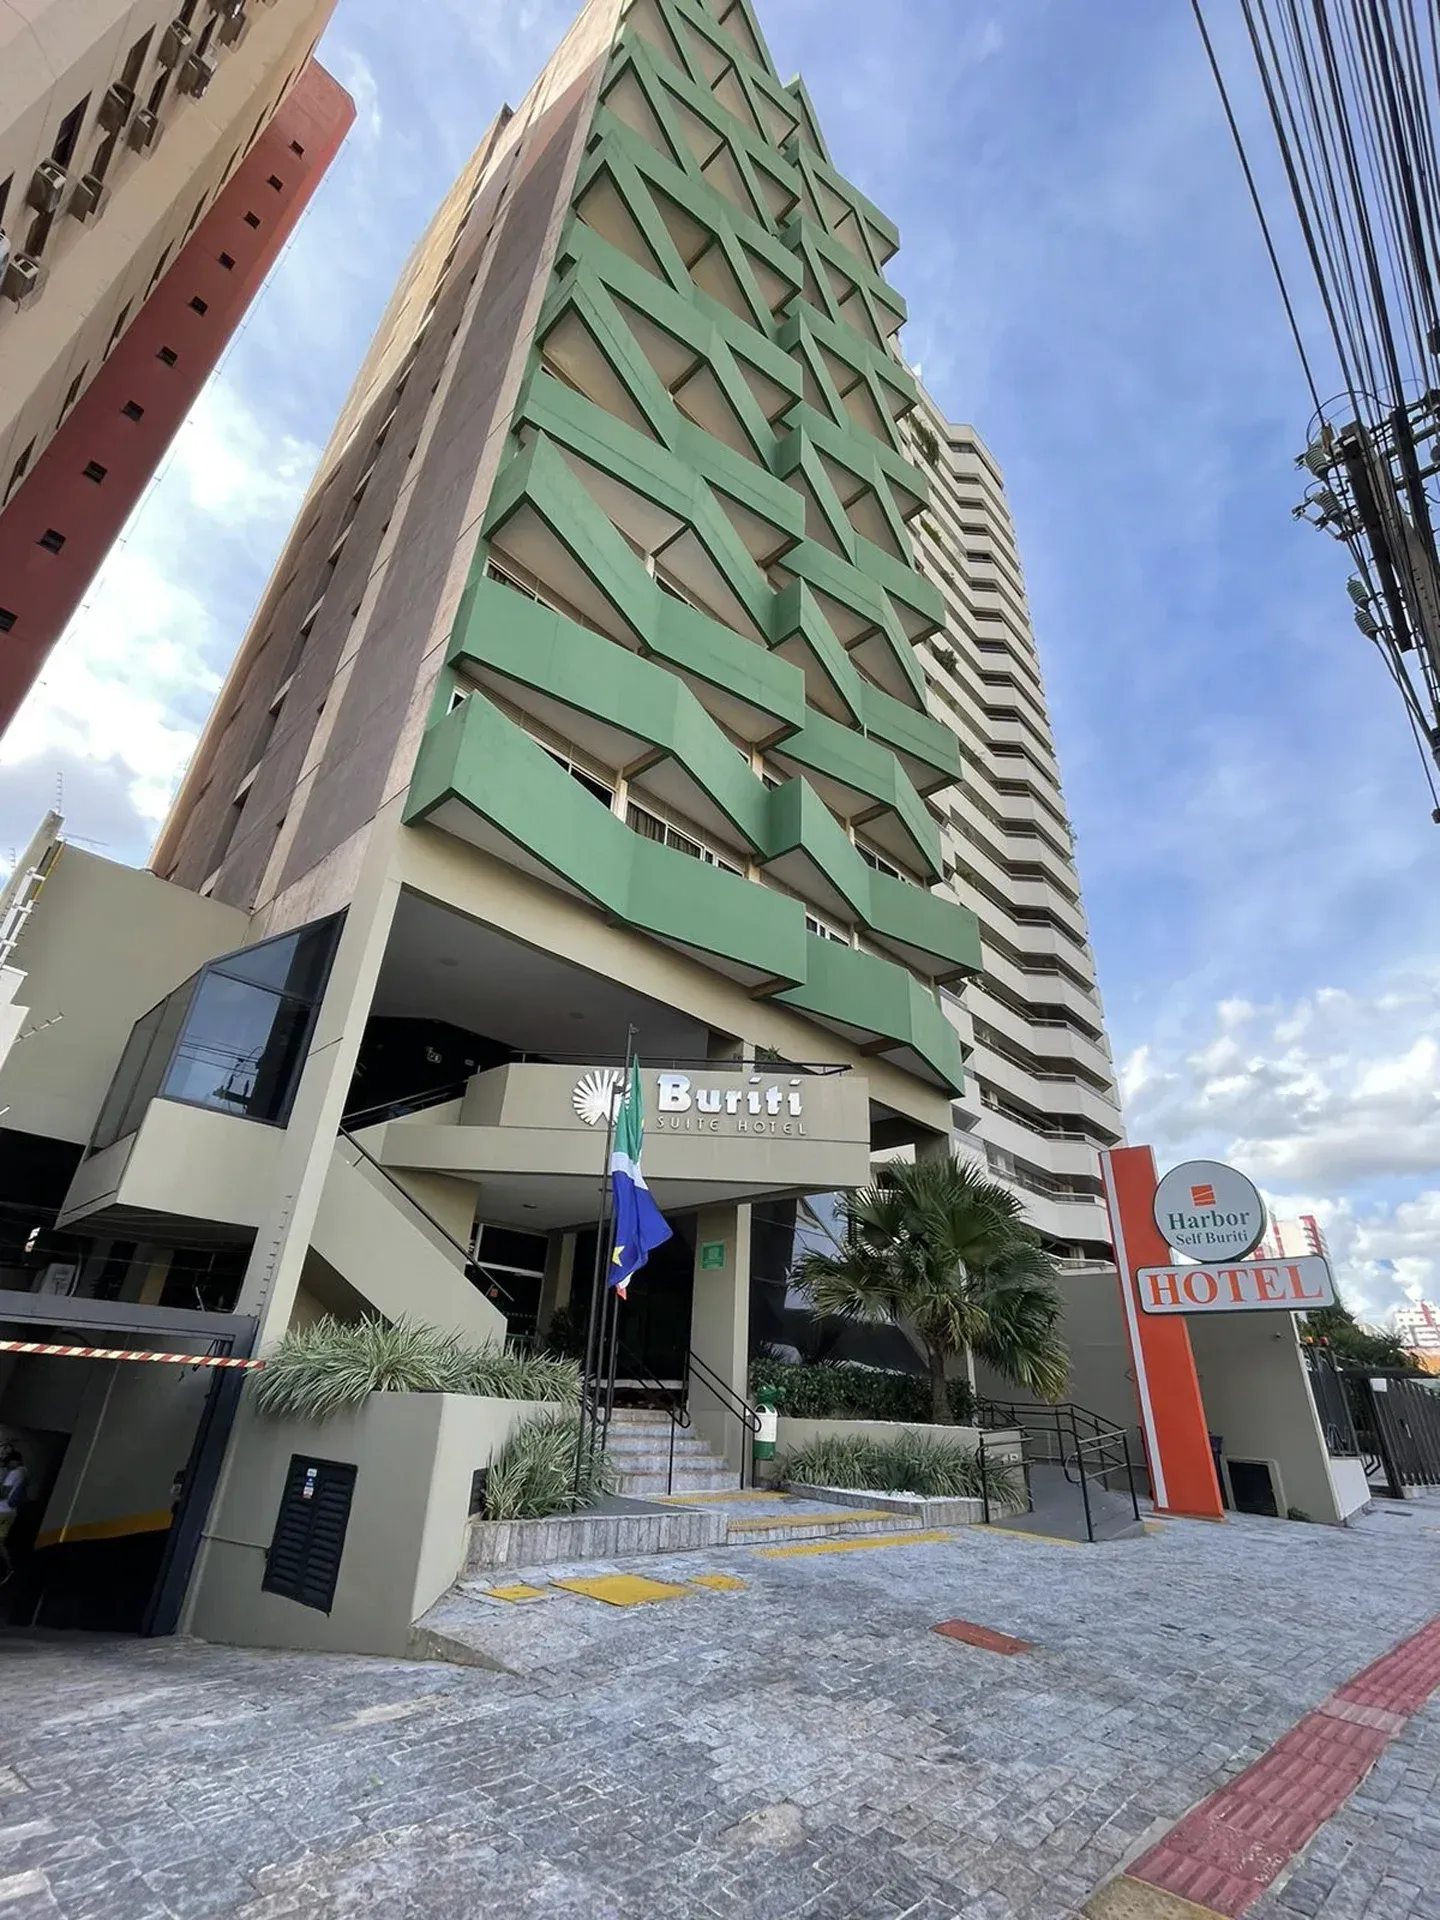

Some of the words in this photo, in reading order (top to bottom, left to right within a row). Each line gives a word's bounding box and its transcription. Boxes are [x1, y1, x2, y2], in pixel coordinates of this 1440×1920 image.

[657, 1074, 803, 1117] Buriti
[657, 1116, 720, 1131] SUITE
[738, 1119, 807, 1136] HOTEL
[1167, 1210, 1250, 1230] Harbor
[1176, 1232, 1202, 1245] Self
[1205, 1230, 1248, 1244] Buriti
[1146, 1265, 1323, 1306] HOTEL
